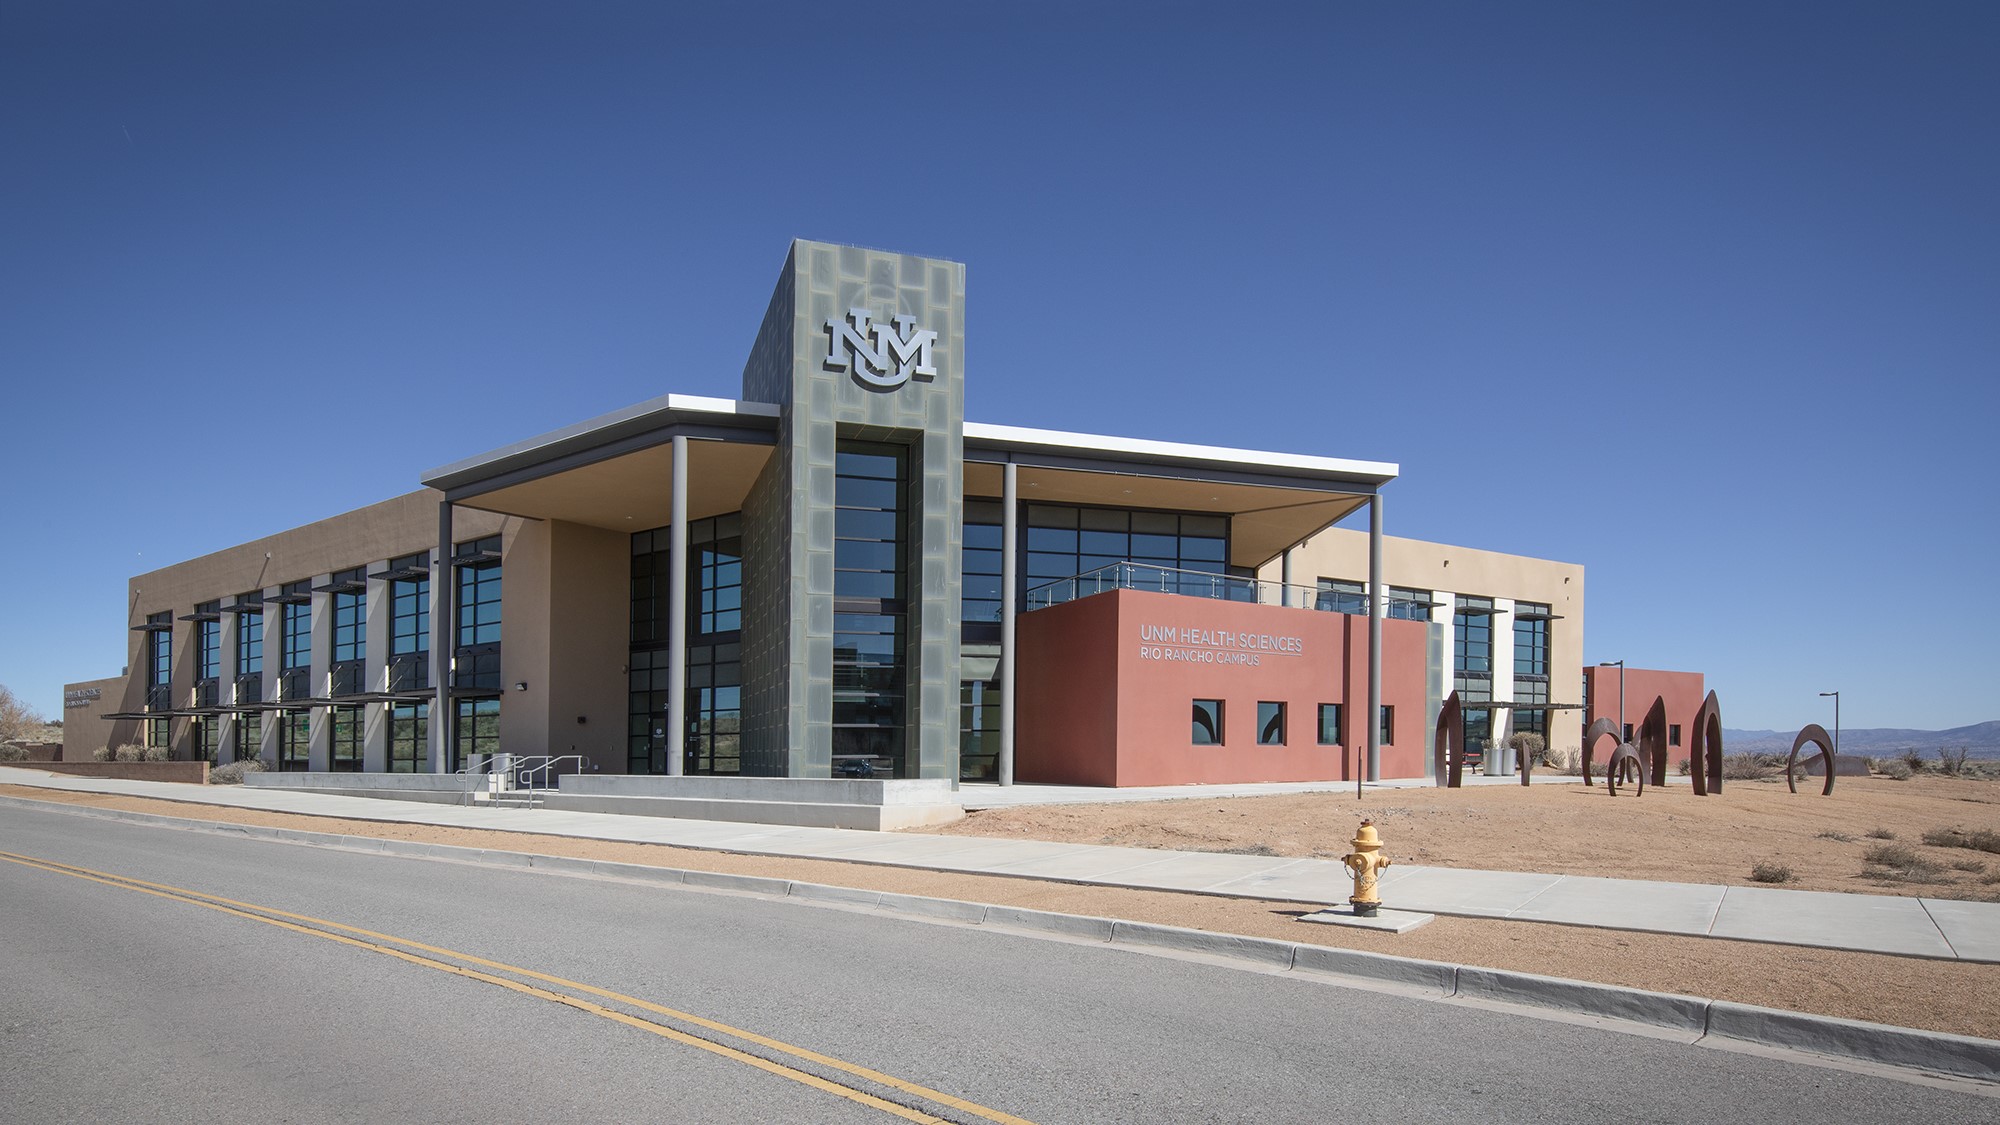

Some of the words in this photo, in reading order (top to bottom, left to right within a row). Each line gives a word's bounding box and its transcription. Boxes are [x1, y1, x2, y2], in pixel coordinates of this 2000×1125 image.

[1141, 624, 1176, 643] UNM
[1180, 628, 1235, 647] HEALTH
[1239, 633, 1302, 652] SCIENCES
[1140, 646, 1162, 660] RIO
[1164, 648, 1214, 663] RANCHO
[1216, 652, 1260, 667] CAMPUS
